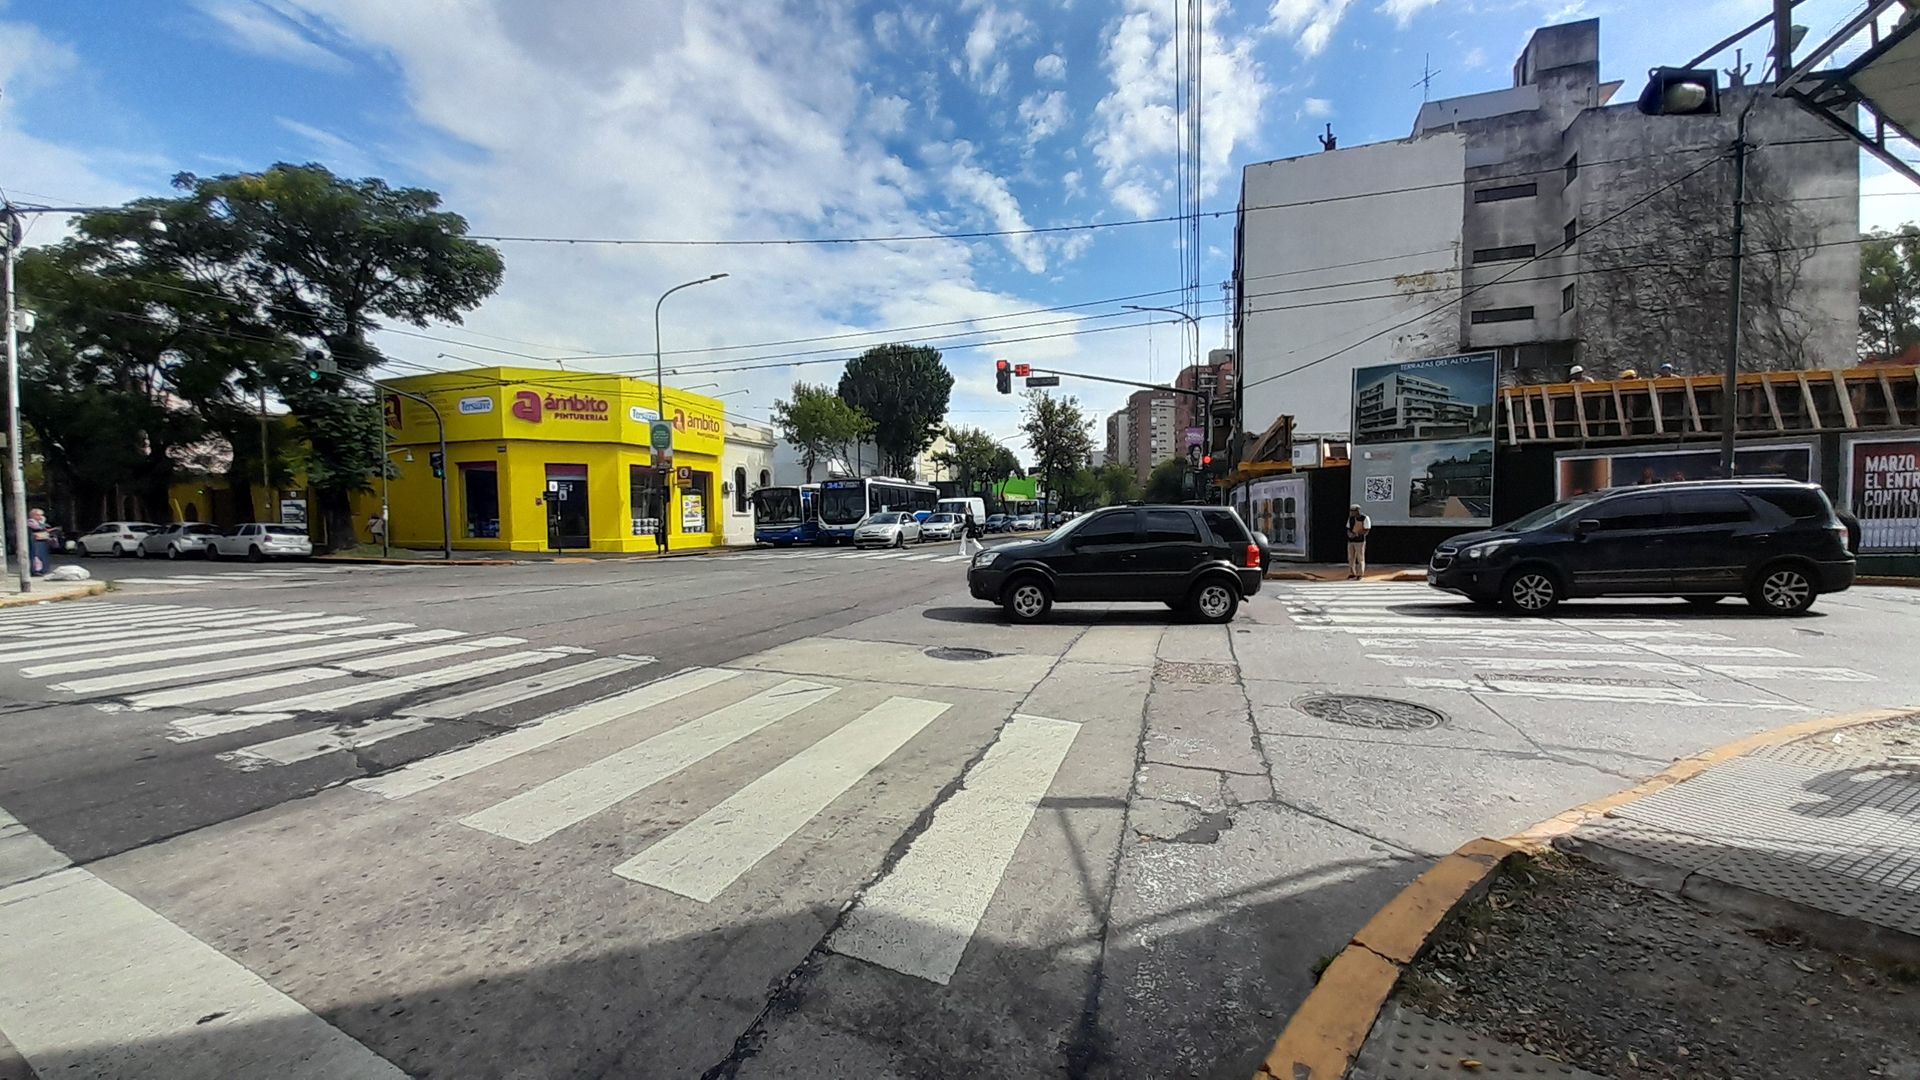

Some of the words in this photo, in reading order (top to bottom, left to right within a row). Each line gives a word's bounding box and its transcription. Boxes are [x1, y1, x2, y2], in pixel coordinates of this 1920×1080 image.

[1400, 361, 1433, 371] TERRAZAS
[1450, 357, 1470, 365] ALTO
[544, 391, 608, 412] ámbito
[554, 412, 608, 421] PINTURERIAS
[687, 412, 720, 433] ámbito
[1865, 473, 1882, 489] EL
[1864, 489, 1920, 506] CONTRA
